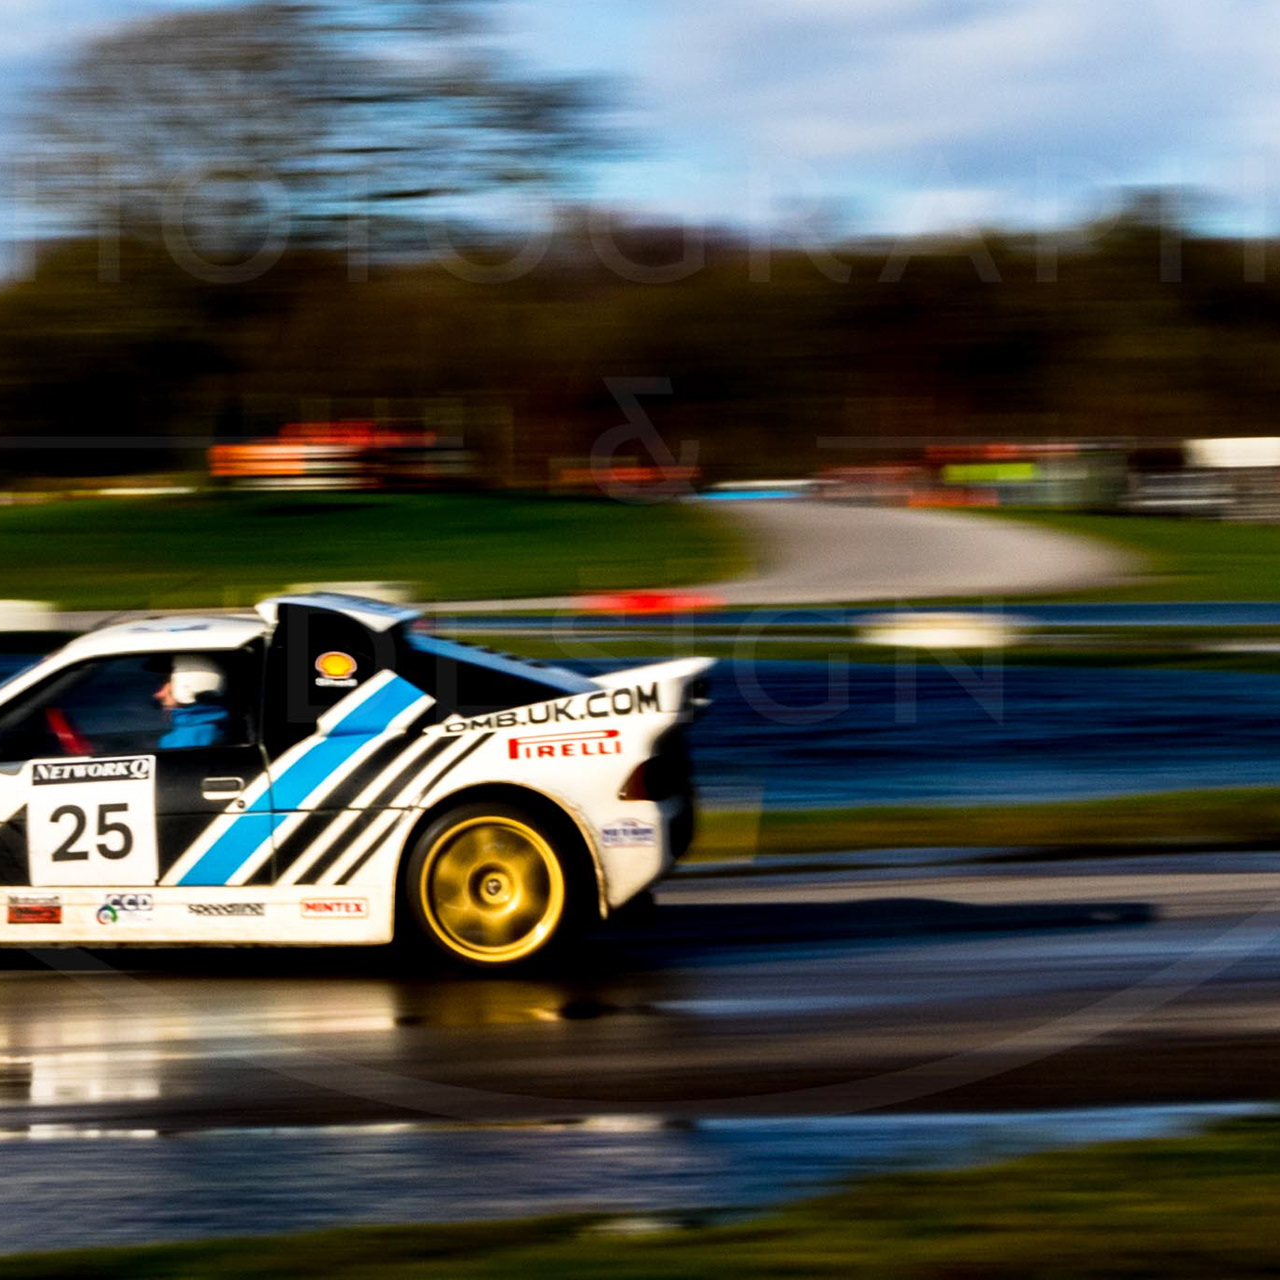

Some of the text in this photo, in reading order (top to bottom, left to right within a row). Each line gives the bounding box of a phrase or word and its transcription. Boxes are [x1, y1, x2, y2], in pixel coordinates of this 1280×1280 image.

[507, 729, 622, 760] PIRELLI
[48, 802, 134, 862] 25
[304, 902, 364, 914] MINTEX
